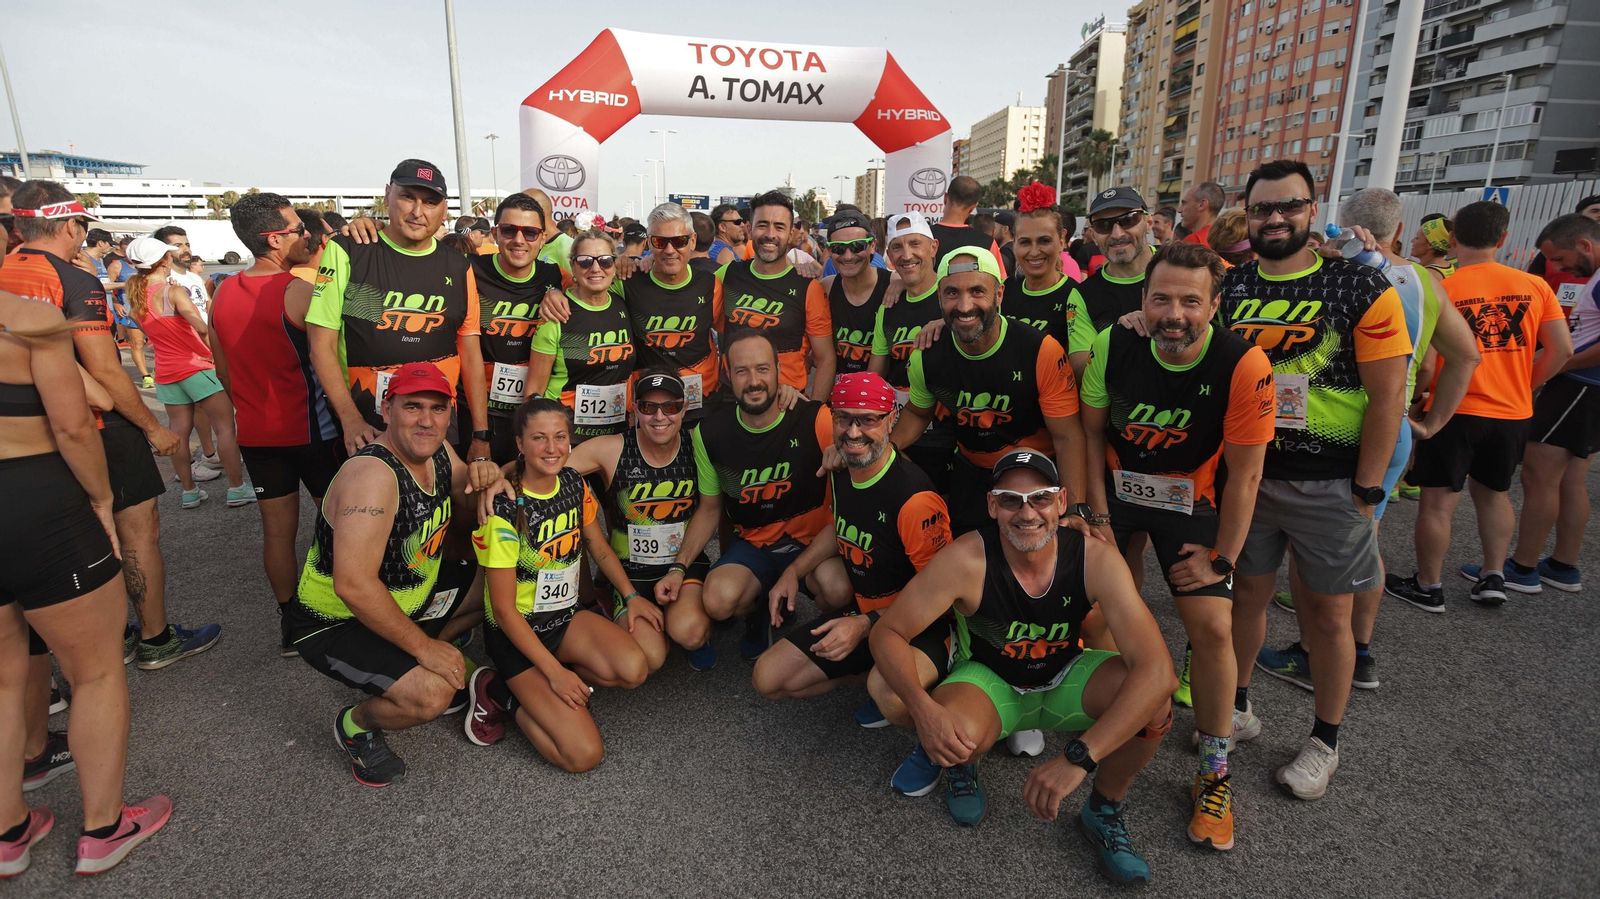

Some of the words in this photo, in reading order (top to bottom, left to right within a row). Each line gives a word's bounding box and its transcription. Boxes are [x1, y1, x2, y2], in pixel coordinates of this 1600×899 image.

[688, 43, 827, 73] TOYOTA
[548, 89, 628, 107] HYBRID
[688, 75, 716, 100] A.
[722, 77, 825, 106] TOMAX
[877, 109, 941, 121] HYBRID
[550, 195, 589, 209] YOTA
[904, 203, 944, 213] TOYOT
[383, 290, 445, 312] non
[735, 293, 784, 315] non
[1455, 297, 1486, 307] CARRERA
[1501, 294, 1533, 302] POPULAR
[1562, 291, 1576, 300] 30
[728, 308, 780, 330] STOP
[1231, 298, 1323, 322] non
[376, 311, 446, 333] STOP
[645, 315, 697, 331] non
[401, 335, 421, 343] team
[588, 328, 628, 347] non
[644, 332, 696, 348] STOP
[893, 325, 922, 342] no
[1230, 323, 1316, 351] TOP
[586, 343, 634, 365] STOP
[496, 377, 524, 394] 570
[580, 399, 607, 414] 512
[956, 389, 1010, 412] non
[957, 408, 1013, 429] STOP
[1128, 402, 1192, 428] non
[1120, 424, 1188, 450] STOP
[740, 461, 790, 486] non
[629, 480, 694, 500] non
[739, 481, 792, 505] STOP
[1122, 480, 1156, 498] 533
[625, 499, 693, 521] STOP
[537, 507, 578, 543] non
[836, 515, 873, 552] non
[535, 528, 580, 567] STOP
[633, 538, 659, 554] 339
[836, 537, 873, 569] STOP
[541, 582, 569, 600] 340
[1005, 620, 1069, 641] non
